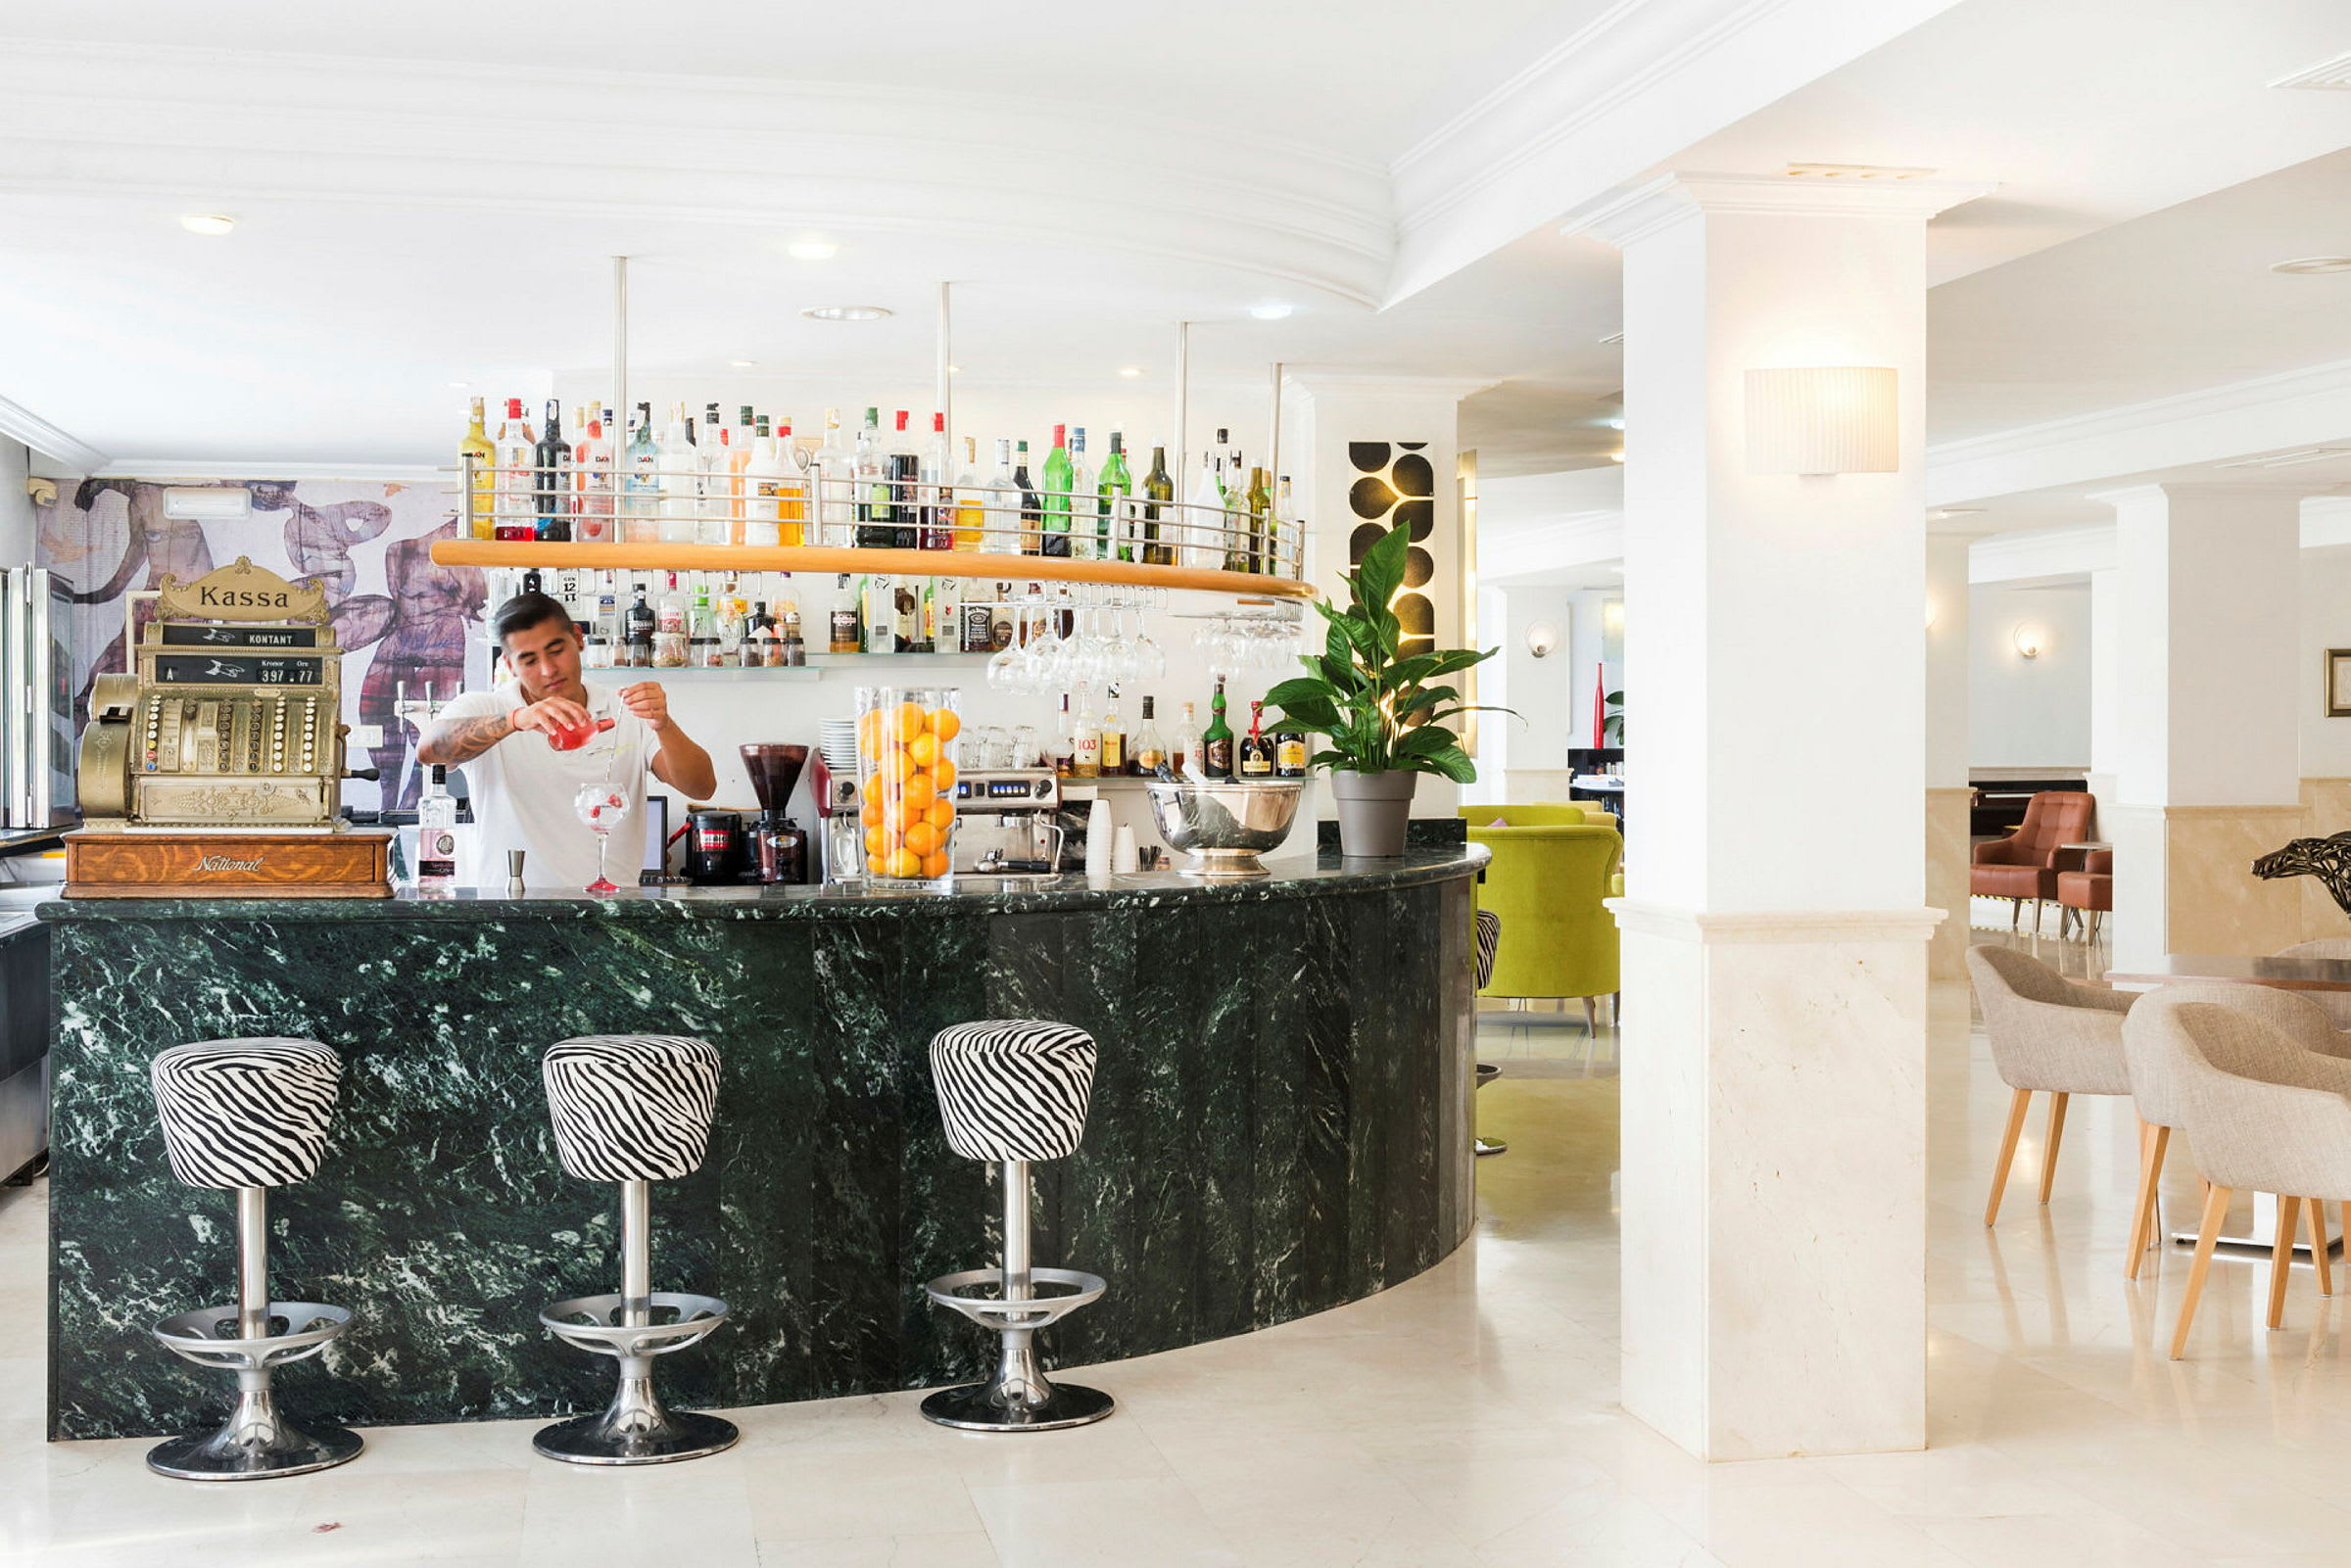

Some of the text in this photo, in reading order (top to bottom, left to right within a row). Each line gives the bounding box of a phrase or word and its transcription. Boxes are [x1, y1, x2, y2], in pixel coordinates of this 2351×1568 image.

[563, 583, 576, 592] 12
[200, 586, 289, 608] Kassa
[249, 634, 293, 644] KONTANT
[166, 668, 173, 681] A
[1078, 738, 1097, 750] 103
[193, 855, 264, 872] National
